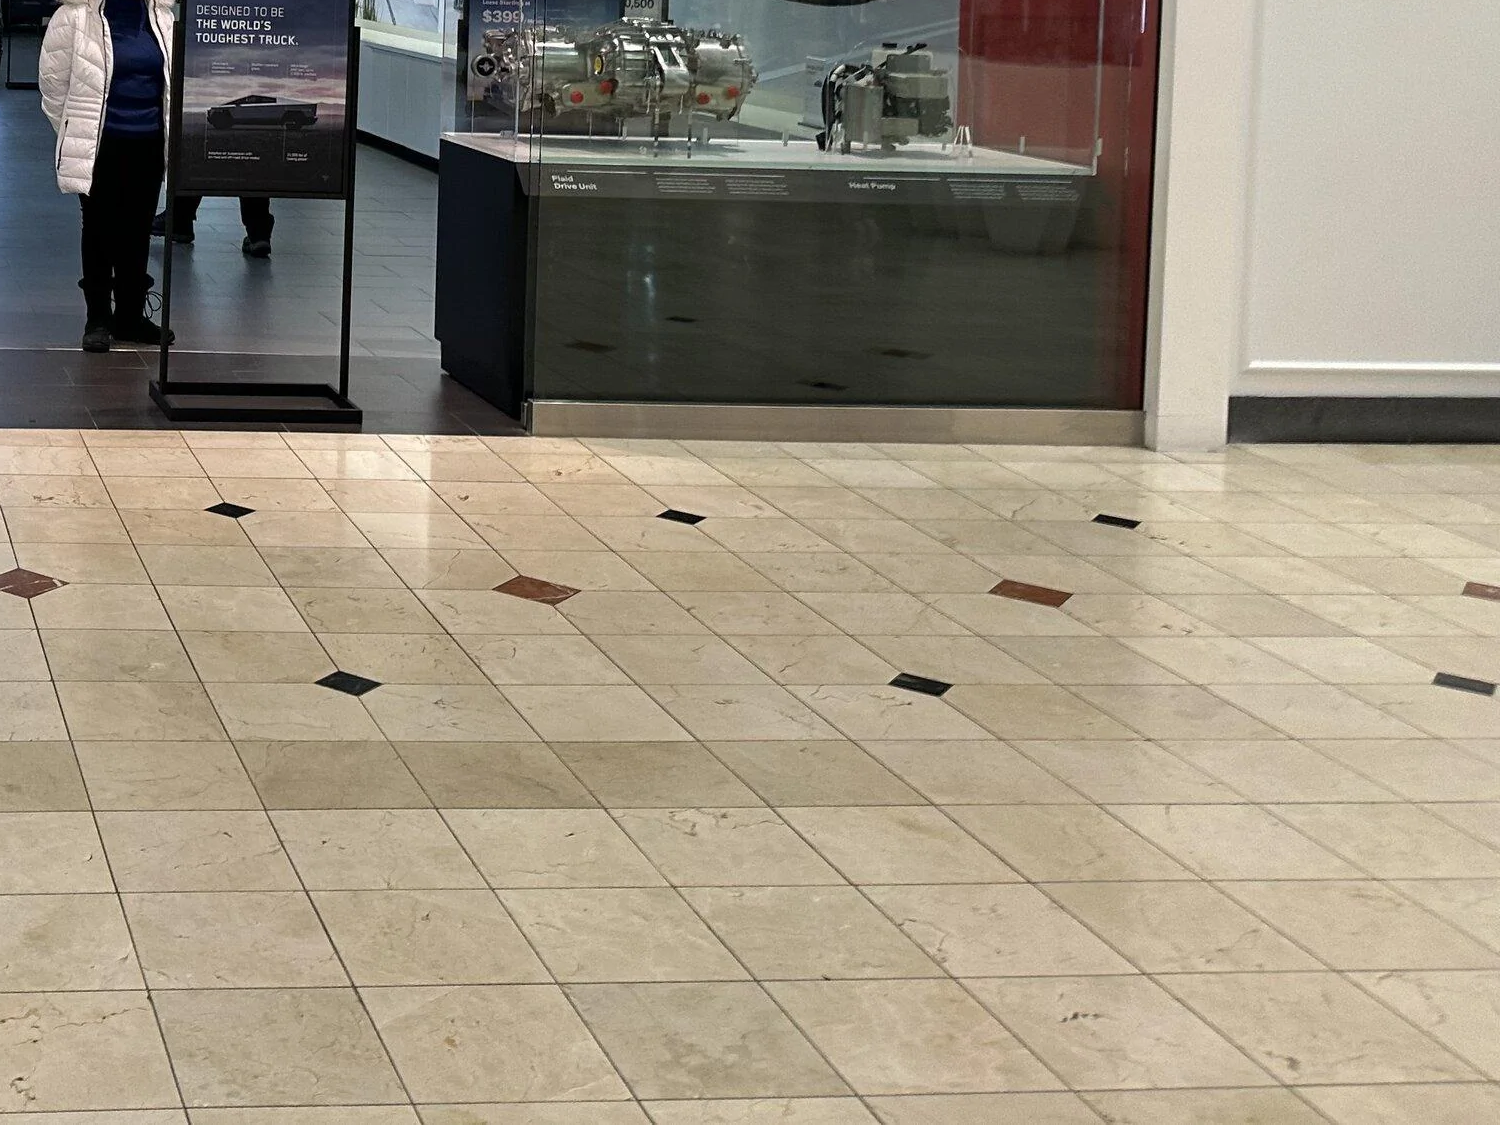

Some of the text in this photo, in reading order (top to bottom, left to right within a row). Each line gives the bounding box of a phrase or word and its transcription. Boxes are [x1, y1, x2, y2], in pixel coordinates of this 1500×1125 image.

[196, 5, 285, 17] DESIGNED TO BE
[482, 9, 524, 23] $399
[196, 19, 272, 31] THE WORLD'S
[196, 33, 299, 46] TOUGHEST TRUCK.
[553, 182, 598, 190] Drive Unit
